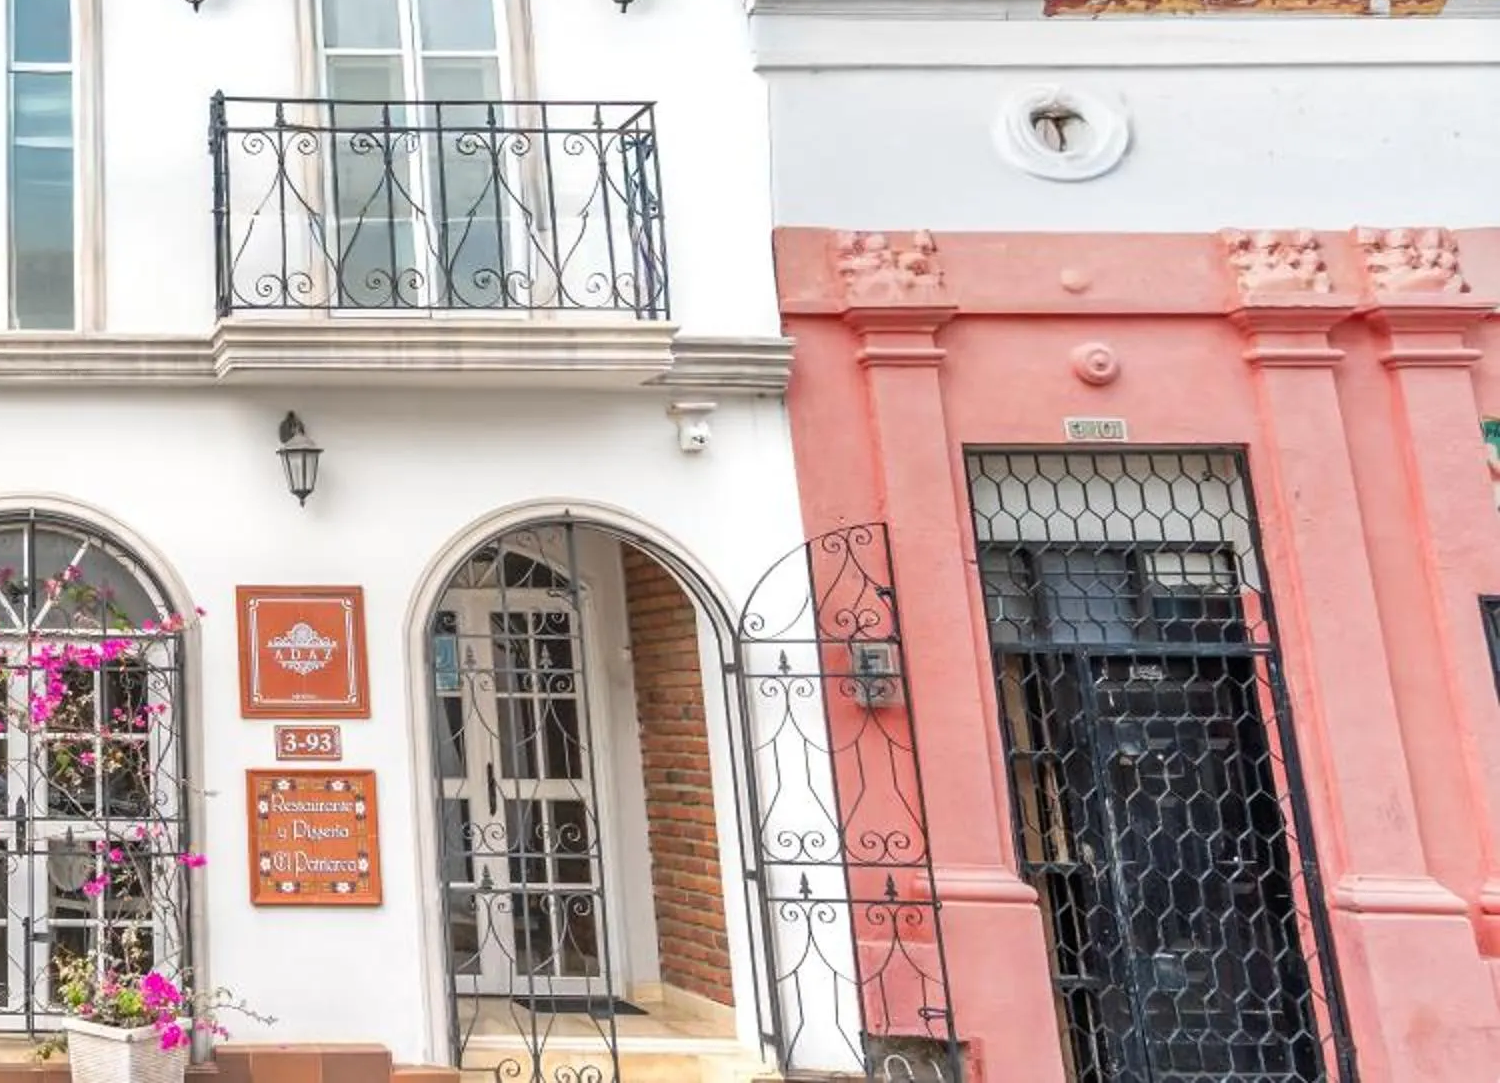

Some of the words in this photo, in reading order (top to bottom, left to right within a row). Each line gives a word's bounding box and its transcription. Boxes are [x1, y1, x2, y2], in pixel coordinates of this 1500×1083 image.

[284, 732, 332, 752] 3-93
[271, 792, 354, 813] Restaurante
[277, 826, 287, 840] y
[273, 850, 291, 871] El
